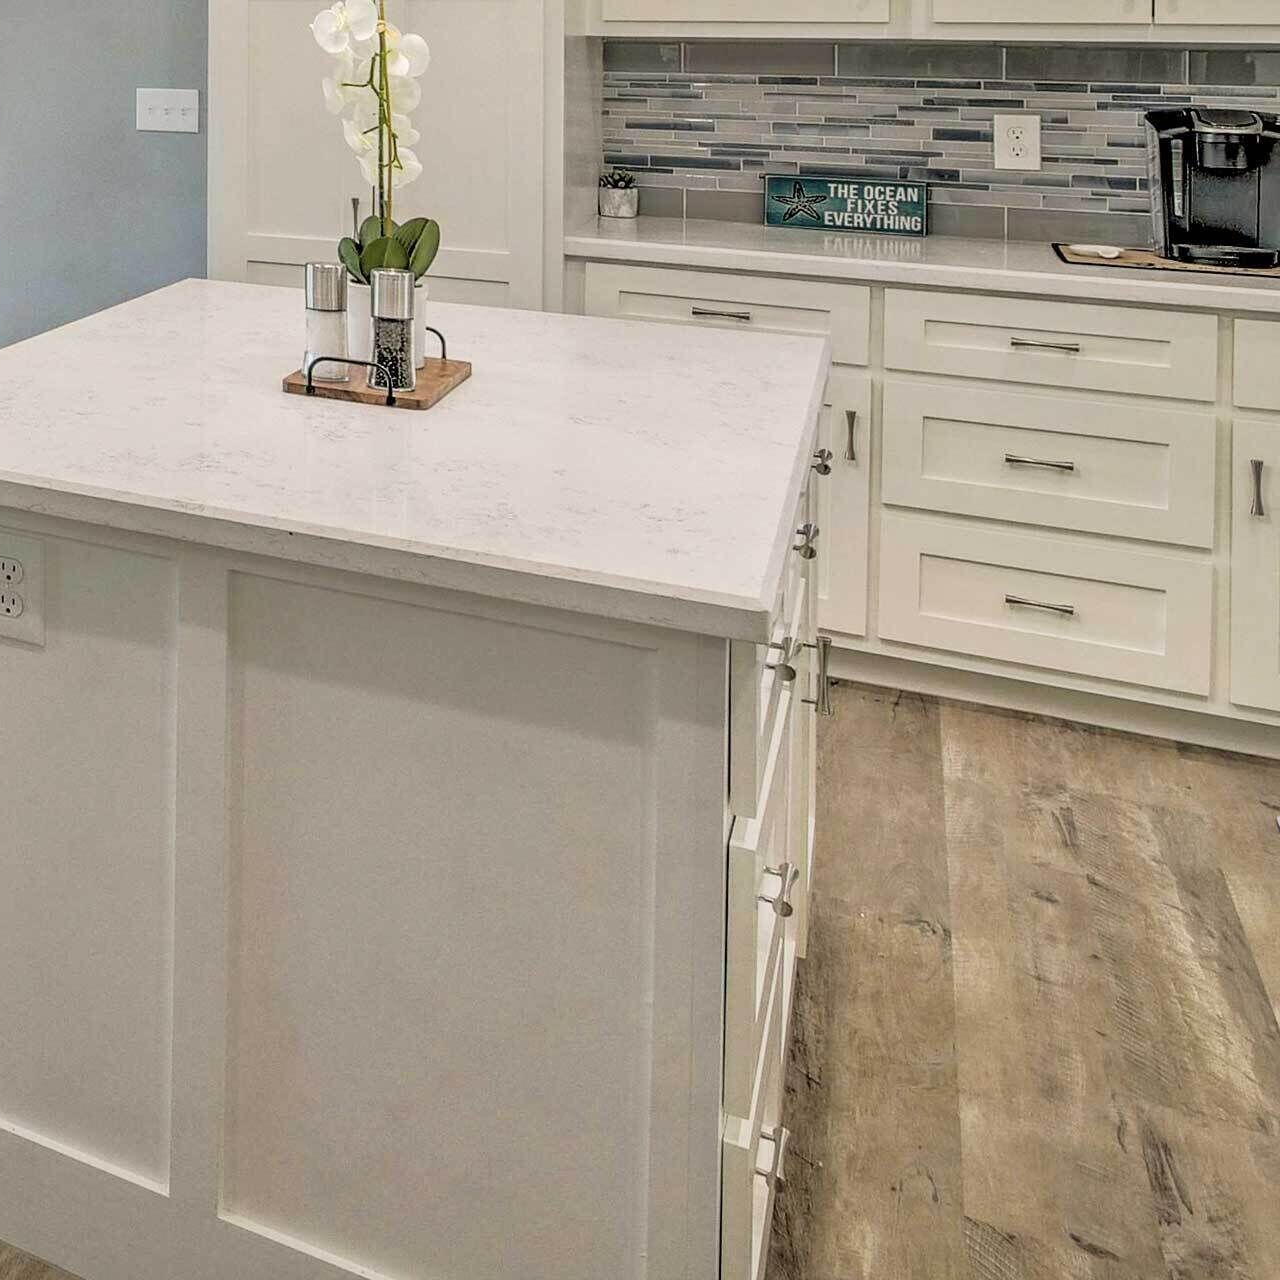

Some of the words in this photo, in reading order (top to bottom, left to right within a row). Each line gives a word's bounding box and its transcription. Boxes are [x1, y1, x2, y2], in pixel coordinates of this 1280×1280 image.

[827, 183, 859, 199] THE
[863, 185, 919, 202] OCEAN
[846, 199, 899, 215] FIXES
[823, 211, 921, 231] EVERYTHING
